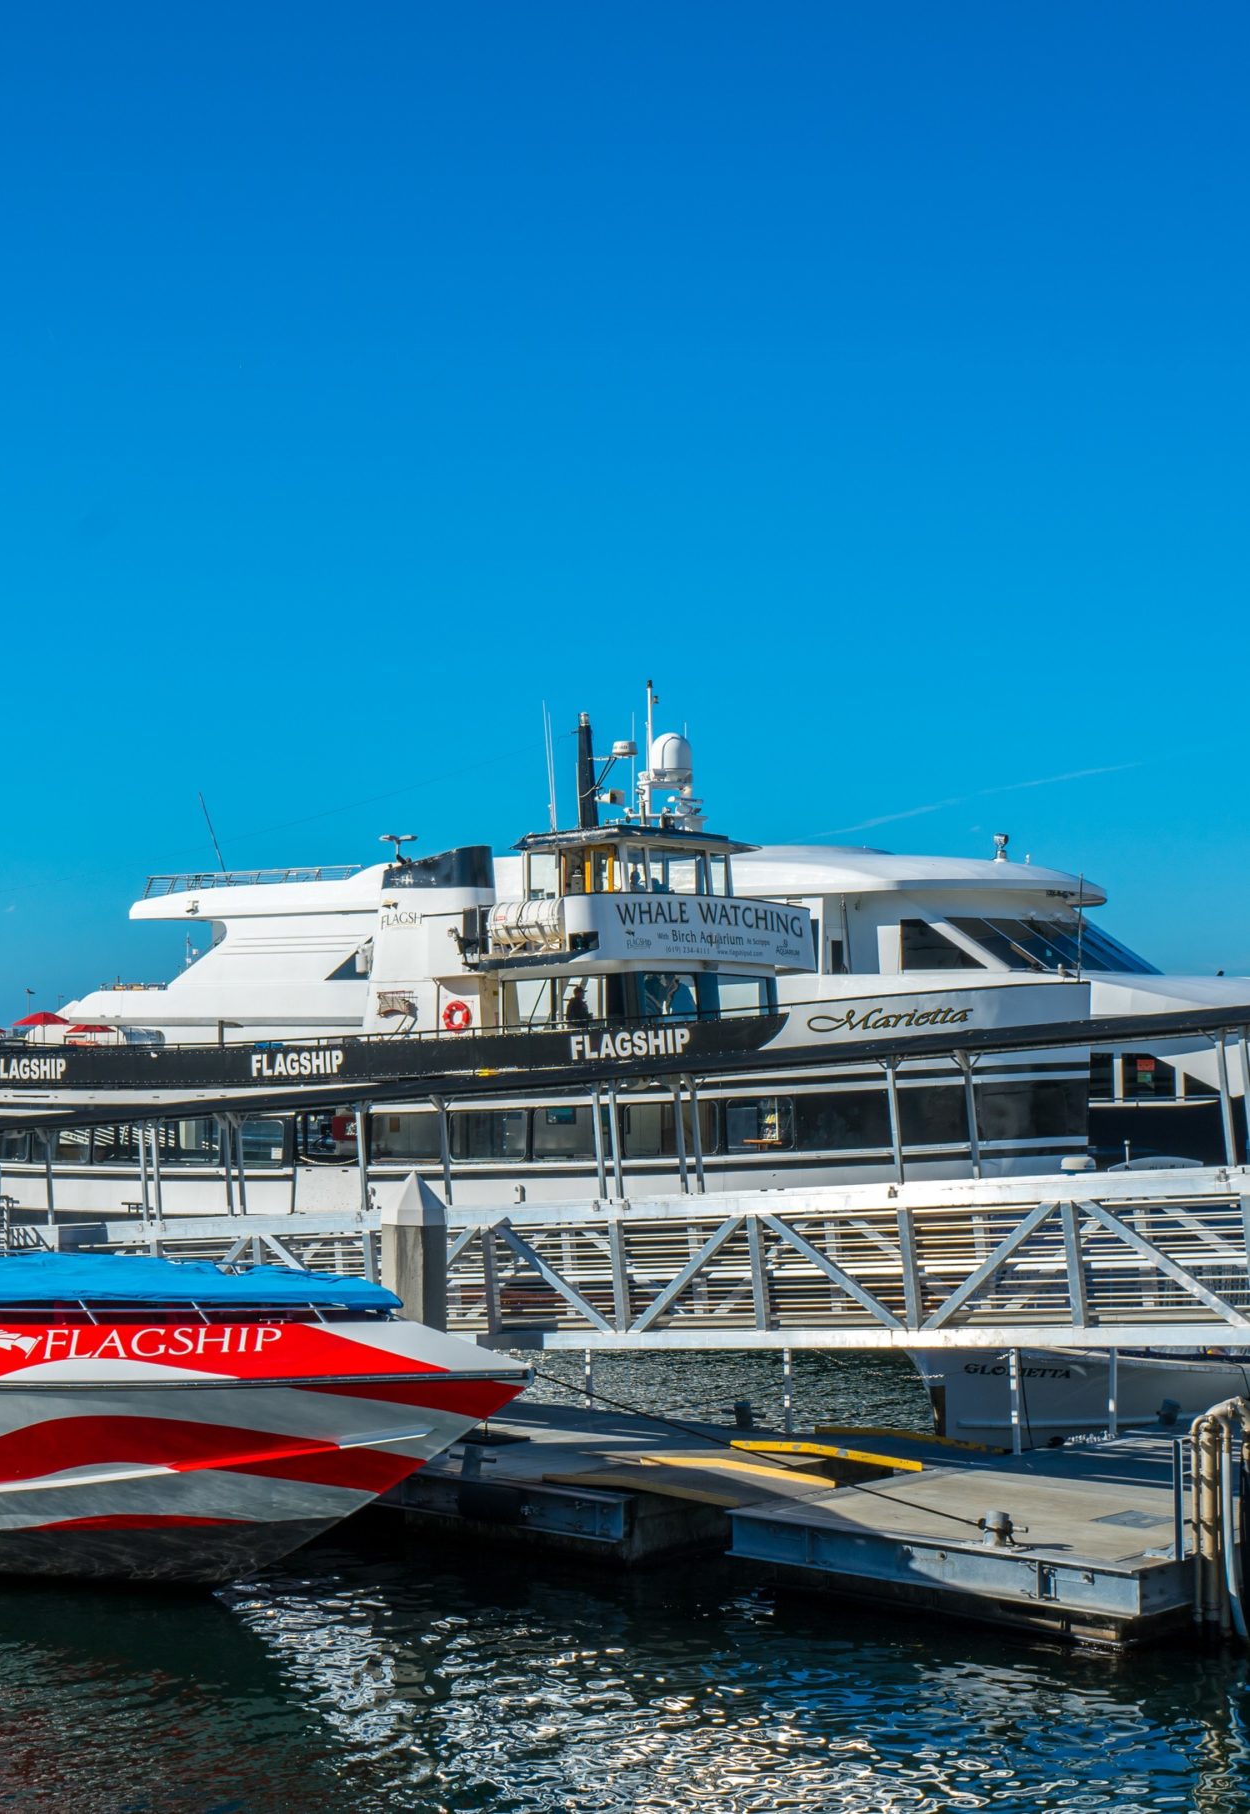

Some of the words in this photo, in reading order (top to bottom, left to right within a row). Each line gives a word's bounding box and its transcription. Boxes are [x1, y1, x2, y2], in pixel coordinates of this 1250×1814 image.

[616, 901, 689, 925] WHALE
[697, 902, 803, 938] WATCHING
[672, 929, 697, 943] Birch
[700, 931, 744, 947] Aquarium
[807, 1007, 973, 1033] Marietta
[570, 1028, 690, 1060] FLAGSHIP
[251, 1050, 343, 1077] FLAGSHIP
[43, 1327, 282, 1360] FLAGSHIP
[964, 1363, 1071, 1379] GLOIETTA
